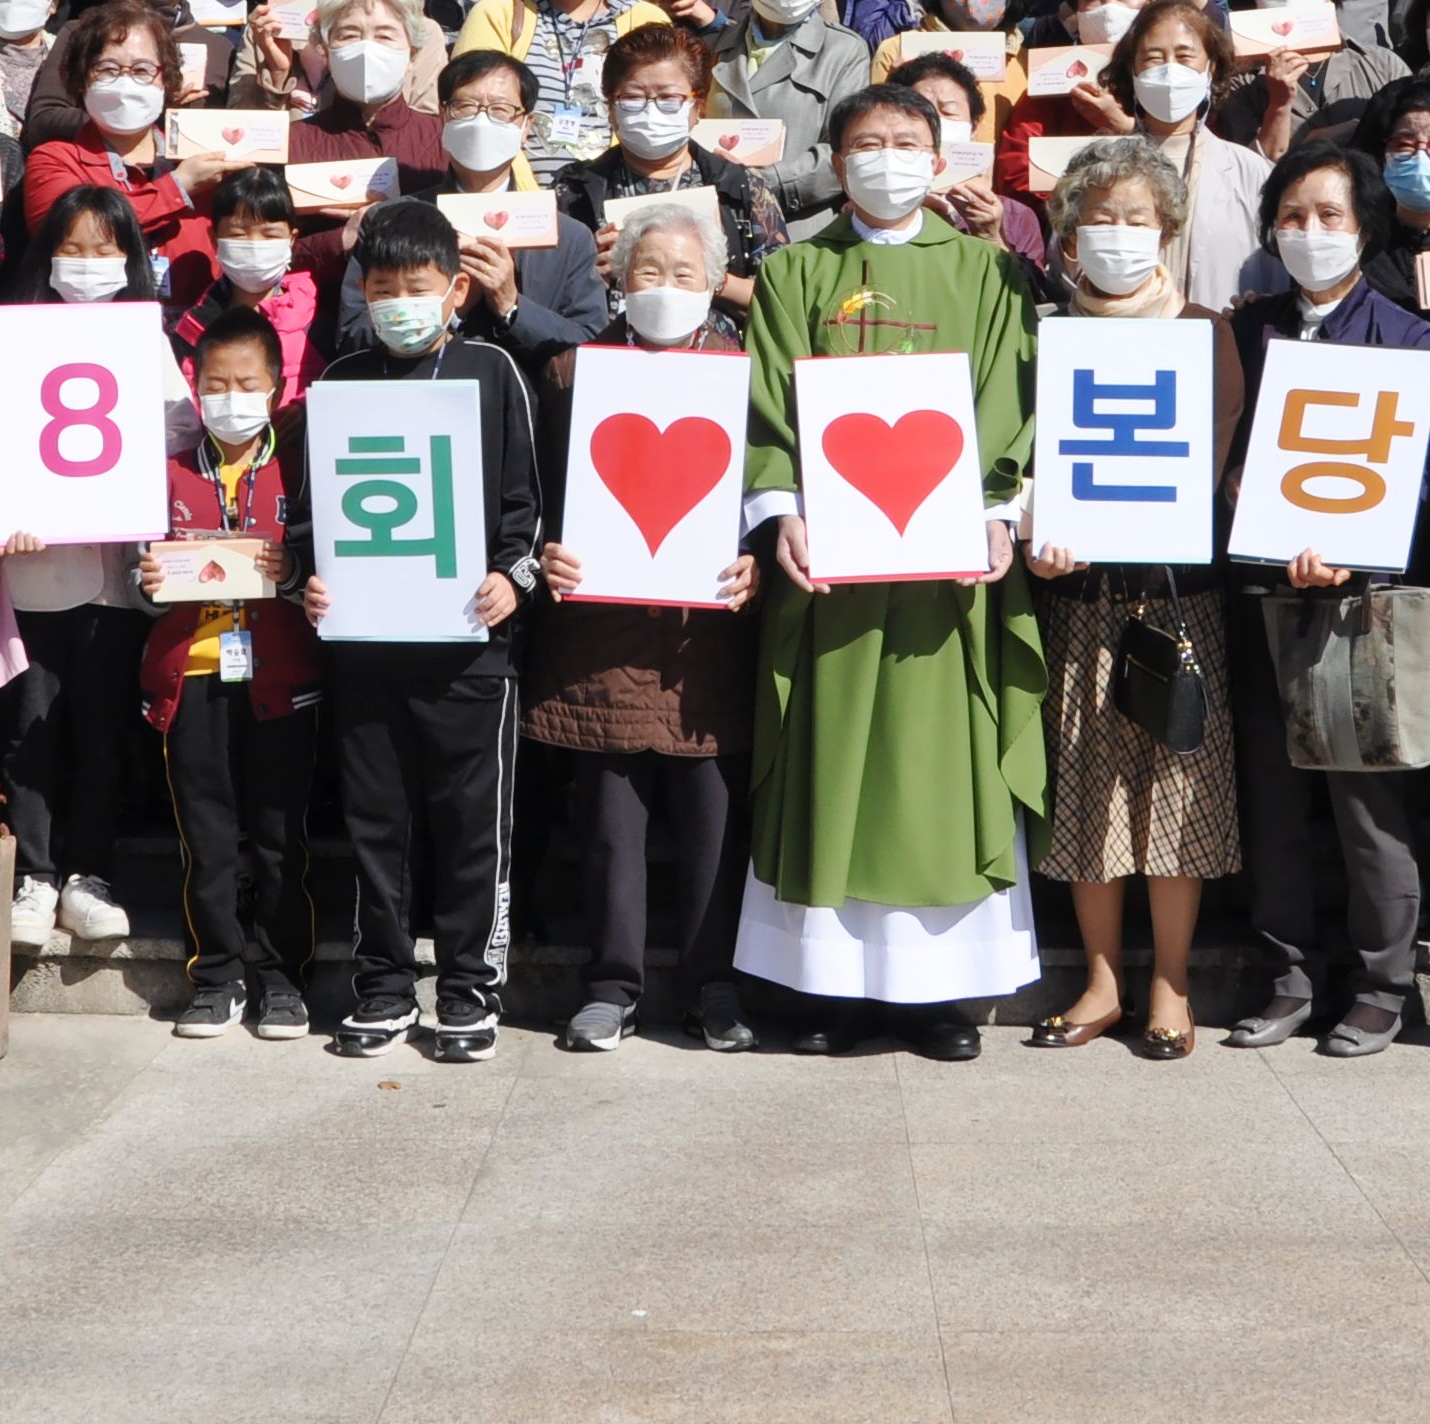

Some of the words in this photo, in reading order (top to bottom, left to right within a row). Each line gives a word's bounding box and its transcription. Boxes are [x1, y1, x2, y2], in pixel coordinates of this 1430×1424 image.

[334, 435, 457, 579] 회
[1058, 368, 1190, 503] 본
[1277, 388, 1415, 514] 당
